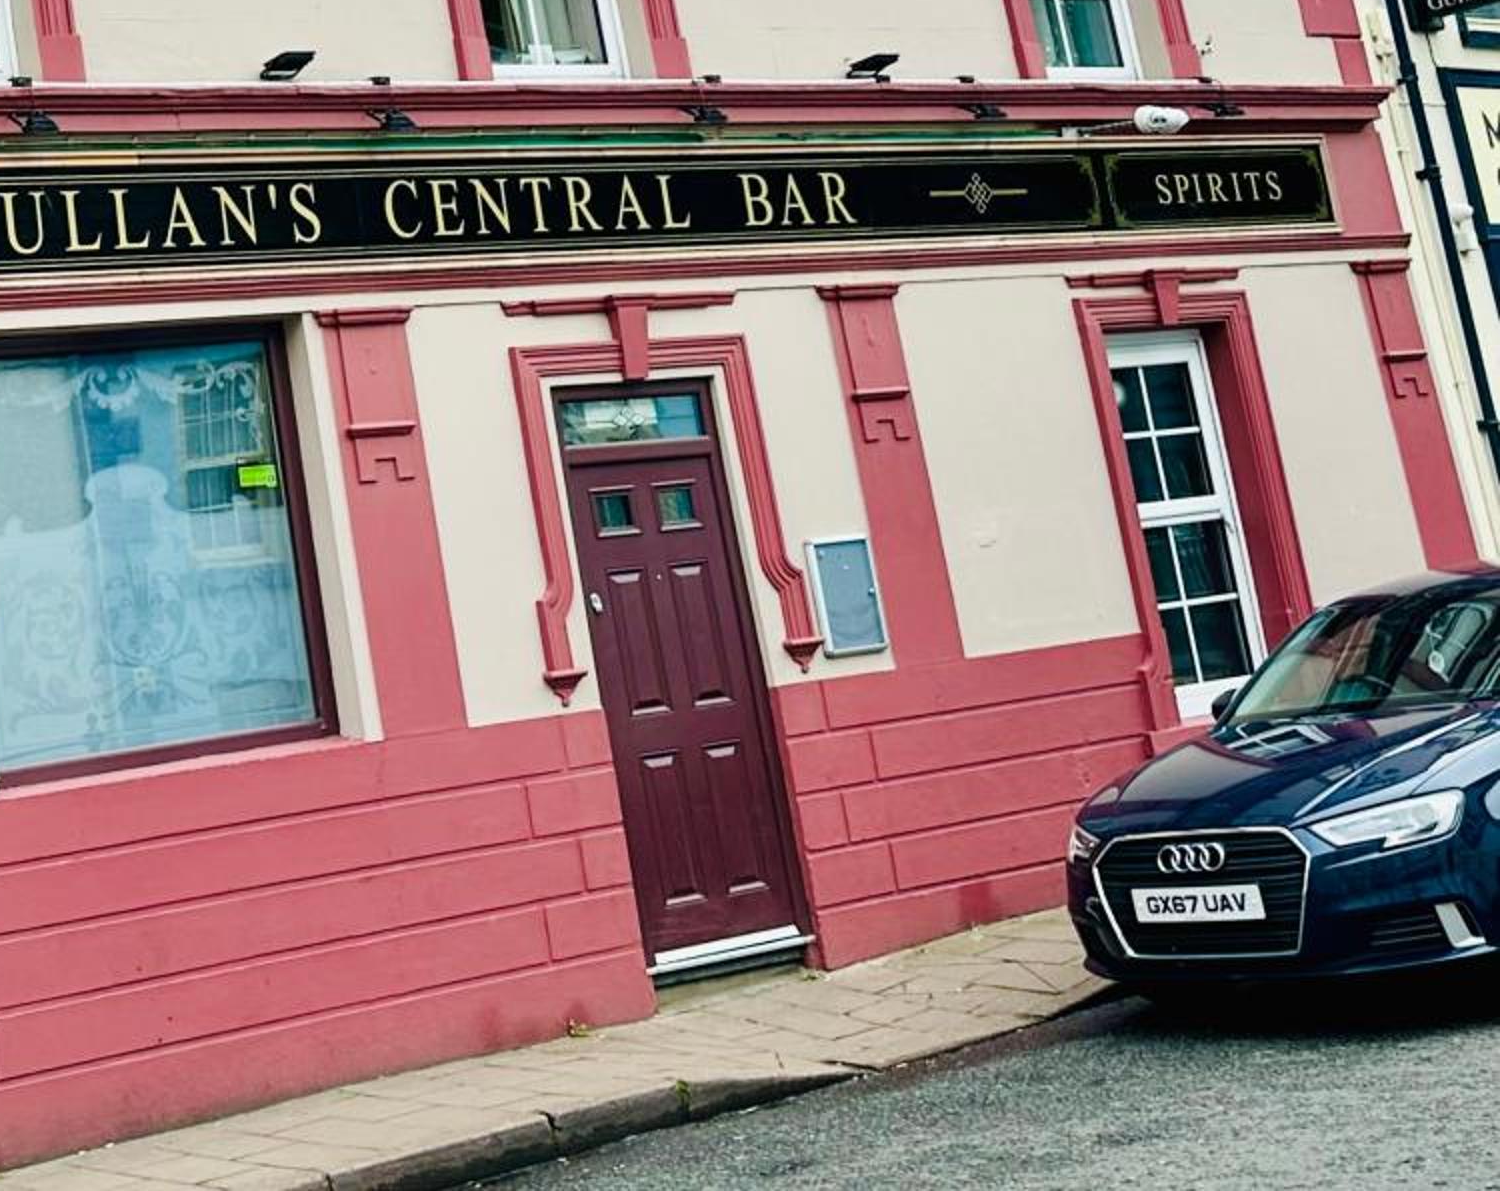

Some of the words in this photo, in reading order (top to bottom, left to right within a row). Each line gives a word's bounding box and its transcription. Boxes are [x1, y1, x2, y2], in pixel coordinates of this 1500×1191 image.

[384, 174, 692, 238] CENTRAL
[737, 172, 858, 227] BAR
[1155, 170, 1283, 205] SPIRITS
[1146, 895, 1198, 914] GX67
[1202, 892, 1246, 912] UAV
